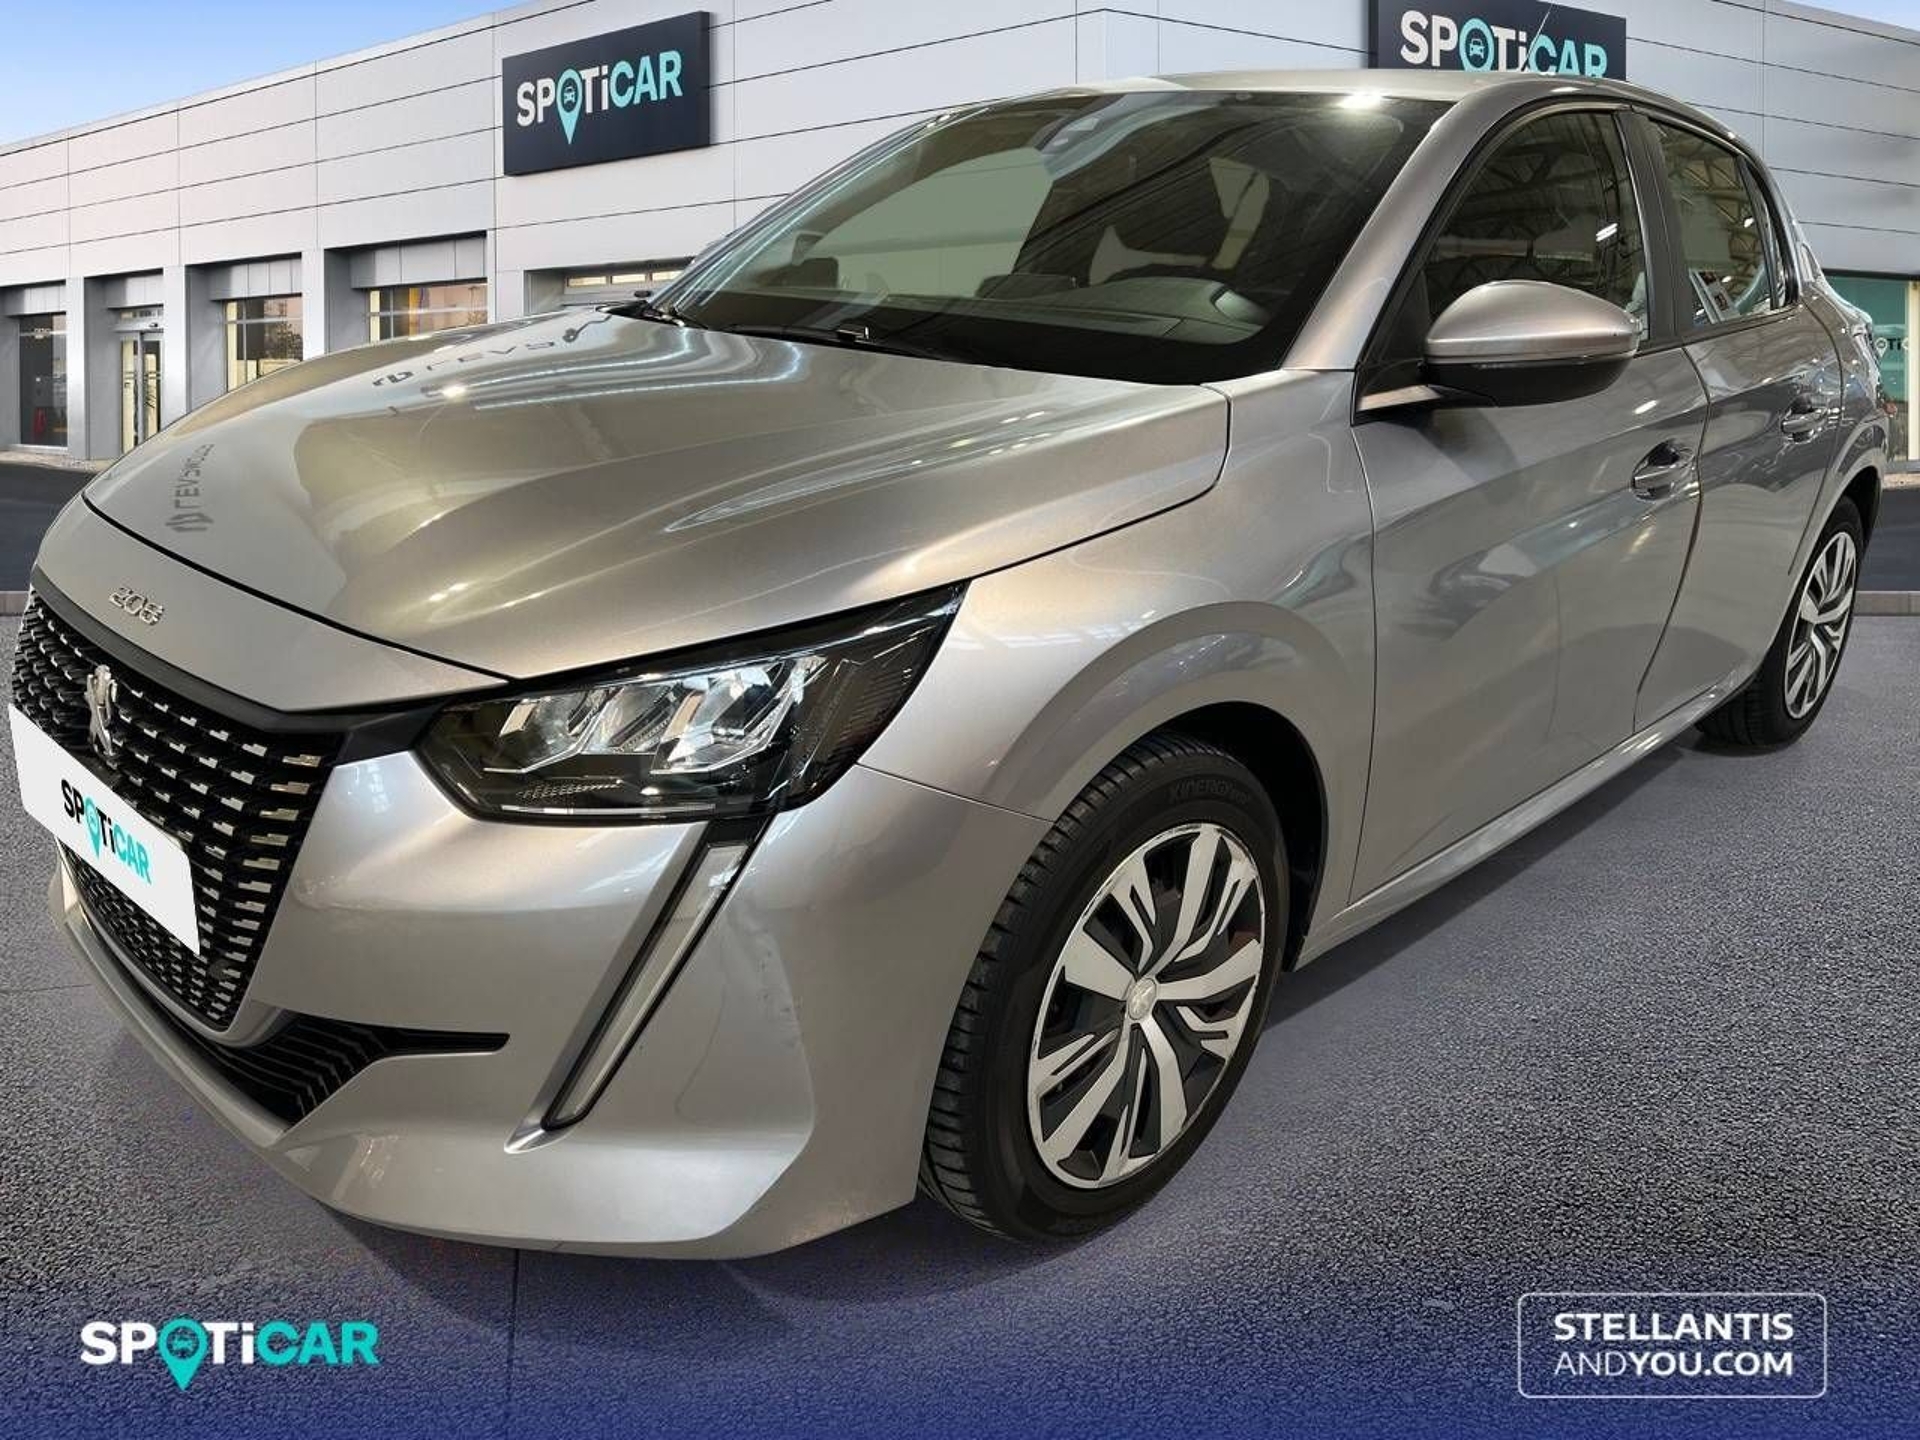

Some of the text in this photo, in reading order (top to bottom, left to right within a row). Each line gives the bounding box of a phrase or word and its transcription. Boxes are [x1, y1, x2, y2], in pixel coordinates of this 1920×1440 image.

[516, 50, 683, 145] SPOTiCAR
[109, 588, 163, 625] 208
[61, 779, 152, 886] SPOTiCAR
